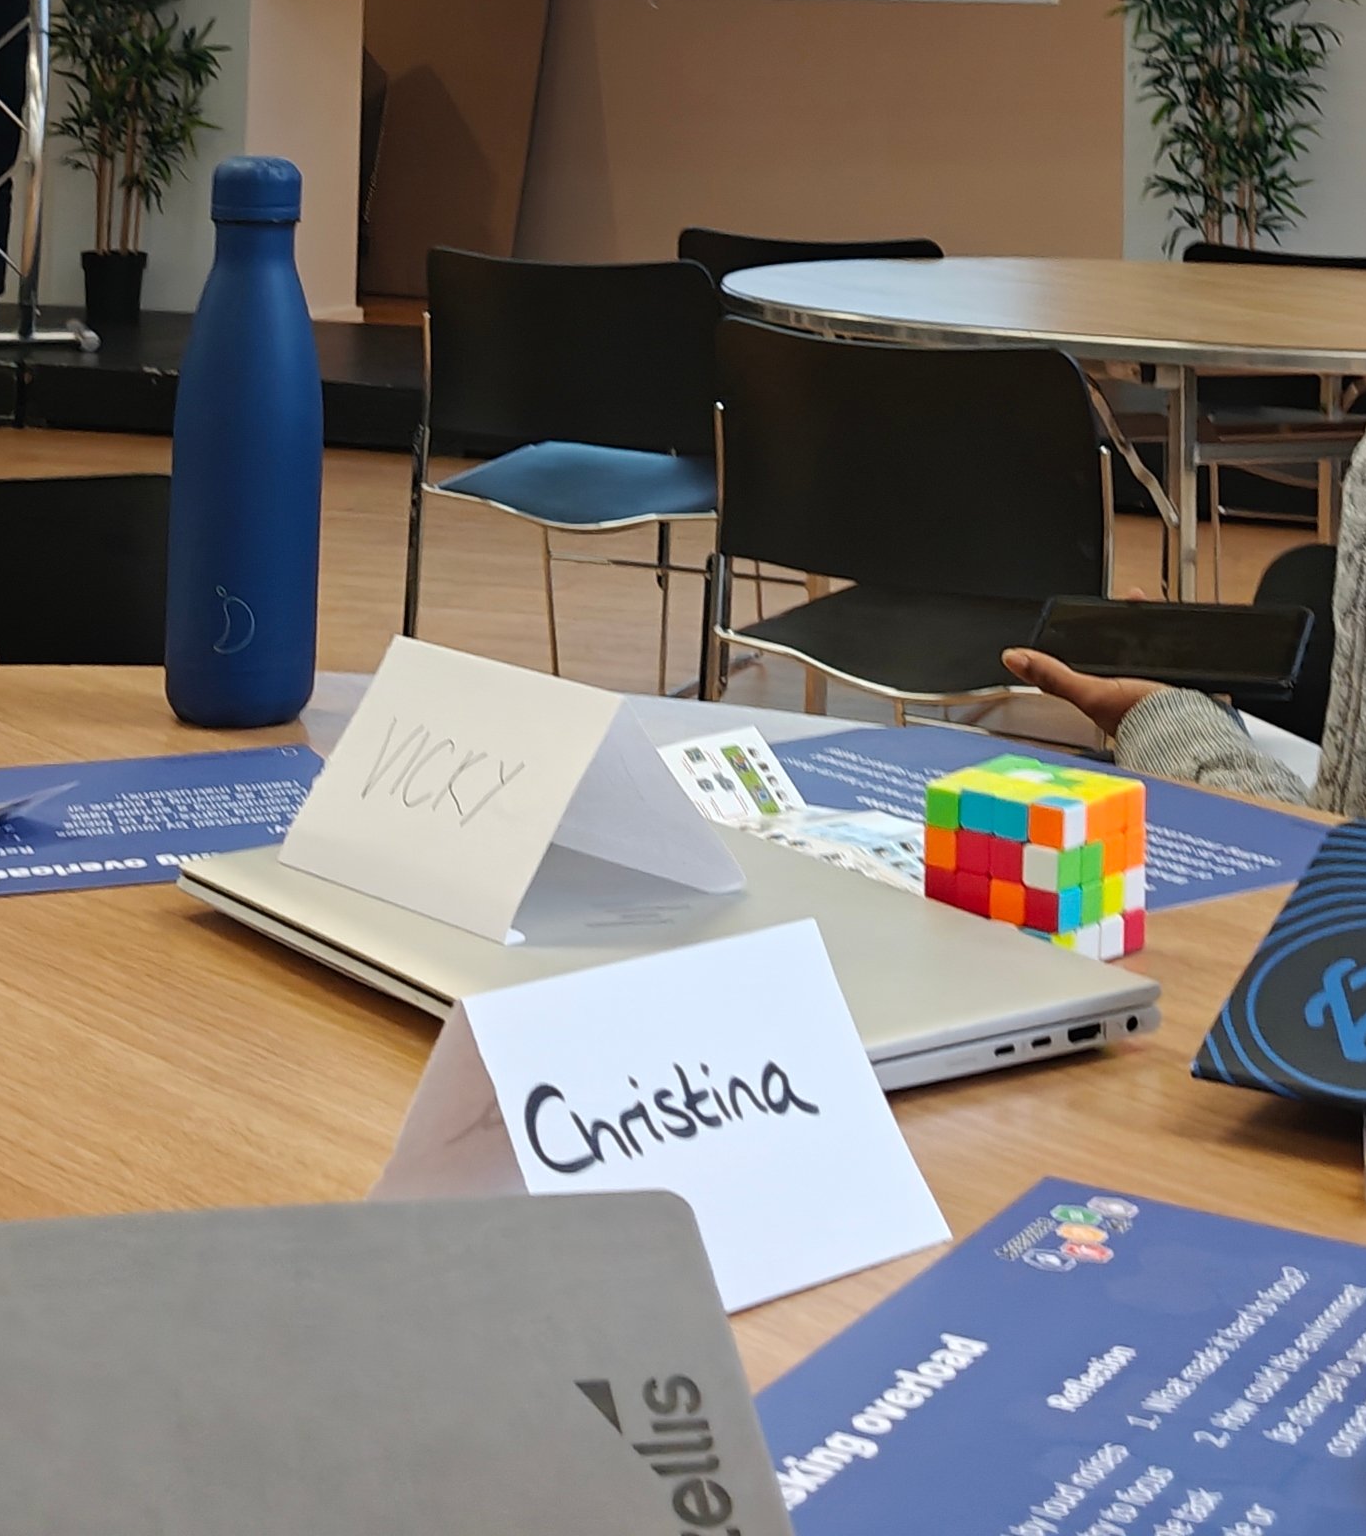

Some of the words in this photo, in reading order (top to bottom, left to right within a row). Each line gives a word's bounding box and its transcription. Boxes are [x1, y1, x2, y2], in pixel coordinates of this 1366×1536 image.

[361, 715, 526, 828] VICKY
[523, 1059, 821, 1174] Christina
[1046, 1345, 1137, 1413] Reflection
[1141, 1377, 1197, 1413] What
[1181, 1345, 1230, 1384] made
[1217, 1310, 1266, 1342] hard
[1257, 1266, 1310, 1306] focus?
[851, 1332, 989, 1436] overload
[1210, 1398, 1260, 1431] How
[1244, 1365, 1290, 1404] could
[1268, 1347, 1310, 1372] the
[1263, 1421, 1305, 1445] be
[1285, 1371, 1348, 1428] changed
[631, 1373, 742, 1536] ellis
[1030, 1482, 1086, 1520] loud
[1071, 1442, 1129, 1489] noises
[1114, 1466, 1174, 1506] focus
[1100, 1500, 1138, 1524] to
